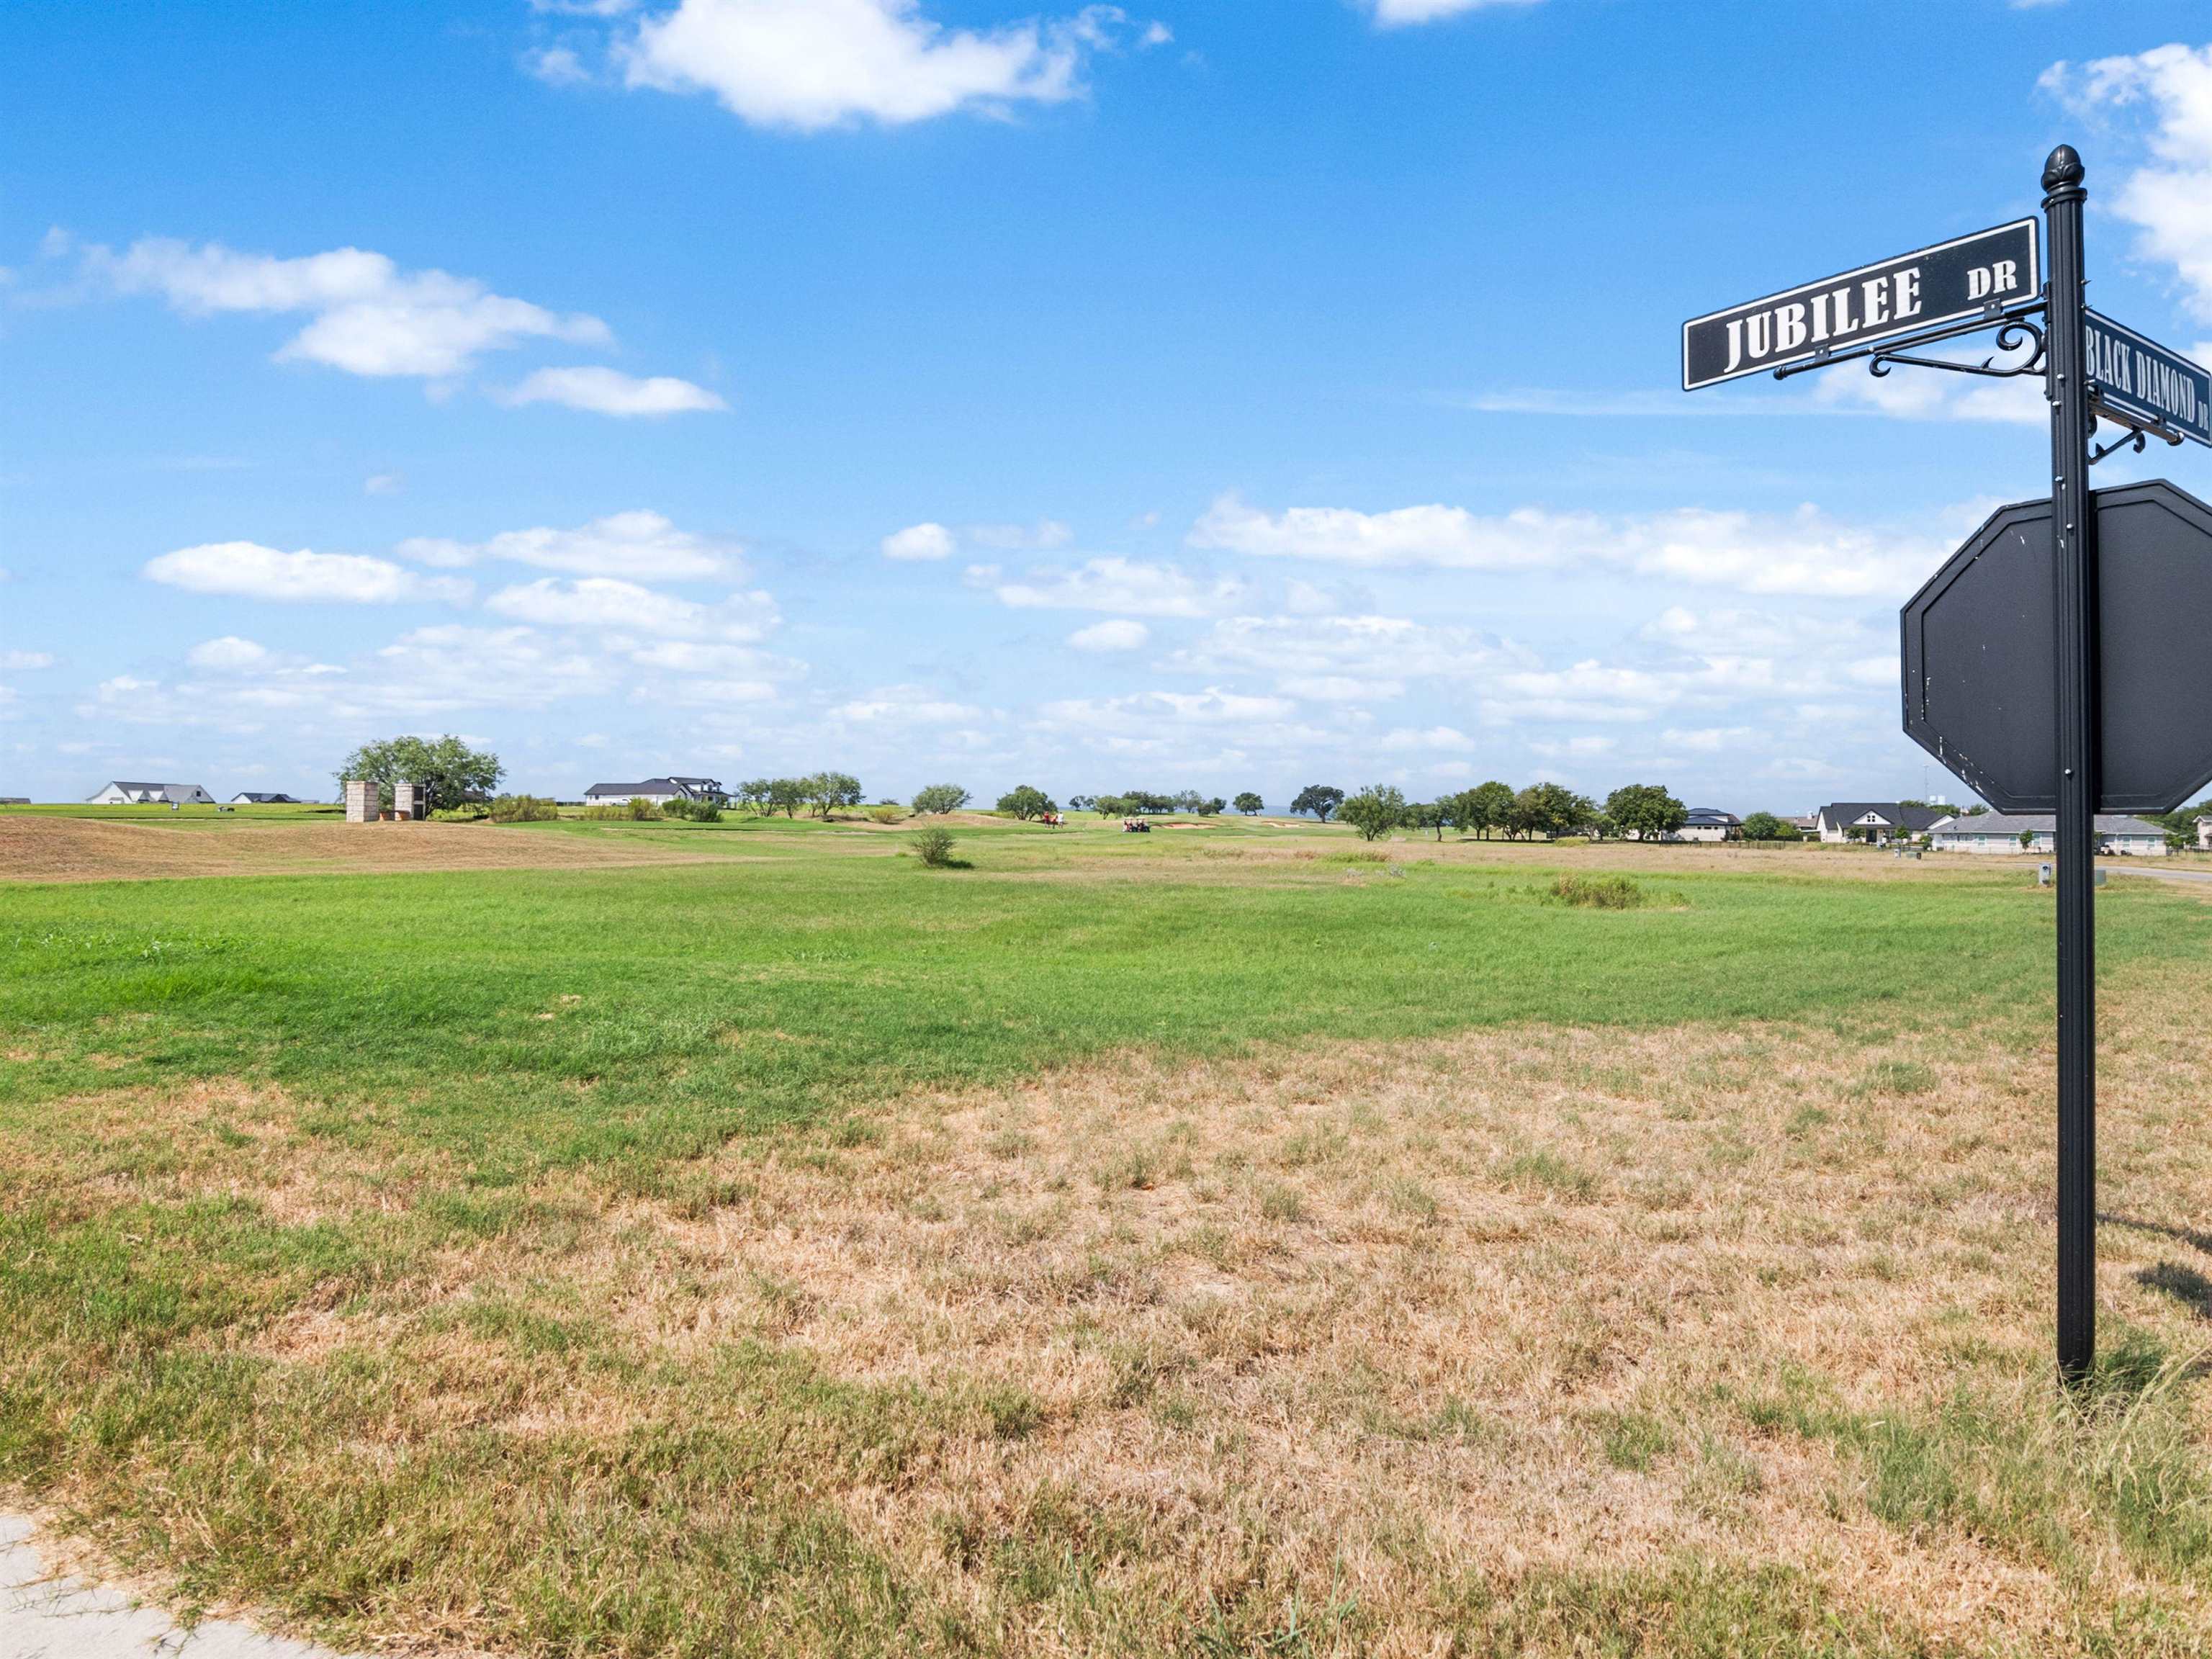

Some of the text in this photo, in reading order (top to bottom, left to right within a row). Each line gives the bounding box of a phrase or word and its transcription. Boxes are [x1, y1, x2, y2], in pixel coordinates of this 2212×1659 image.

[1724, 259, 2018, 373] JUBILEE DR
[2085, 325, 2209, 431] BLACK DIAMOND DR
